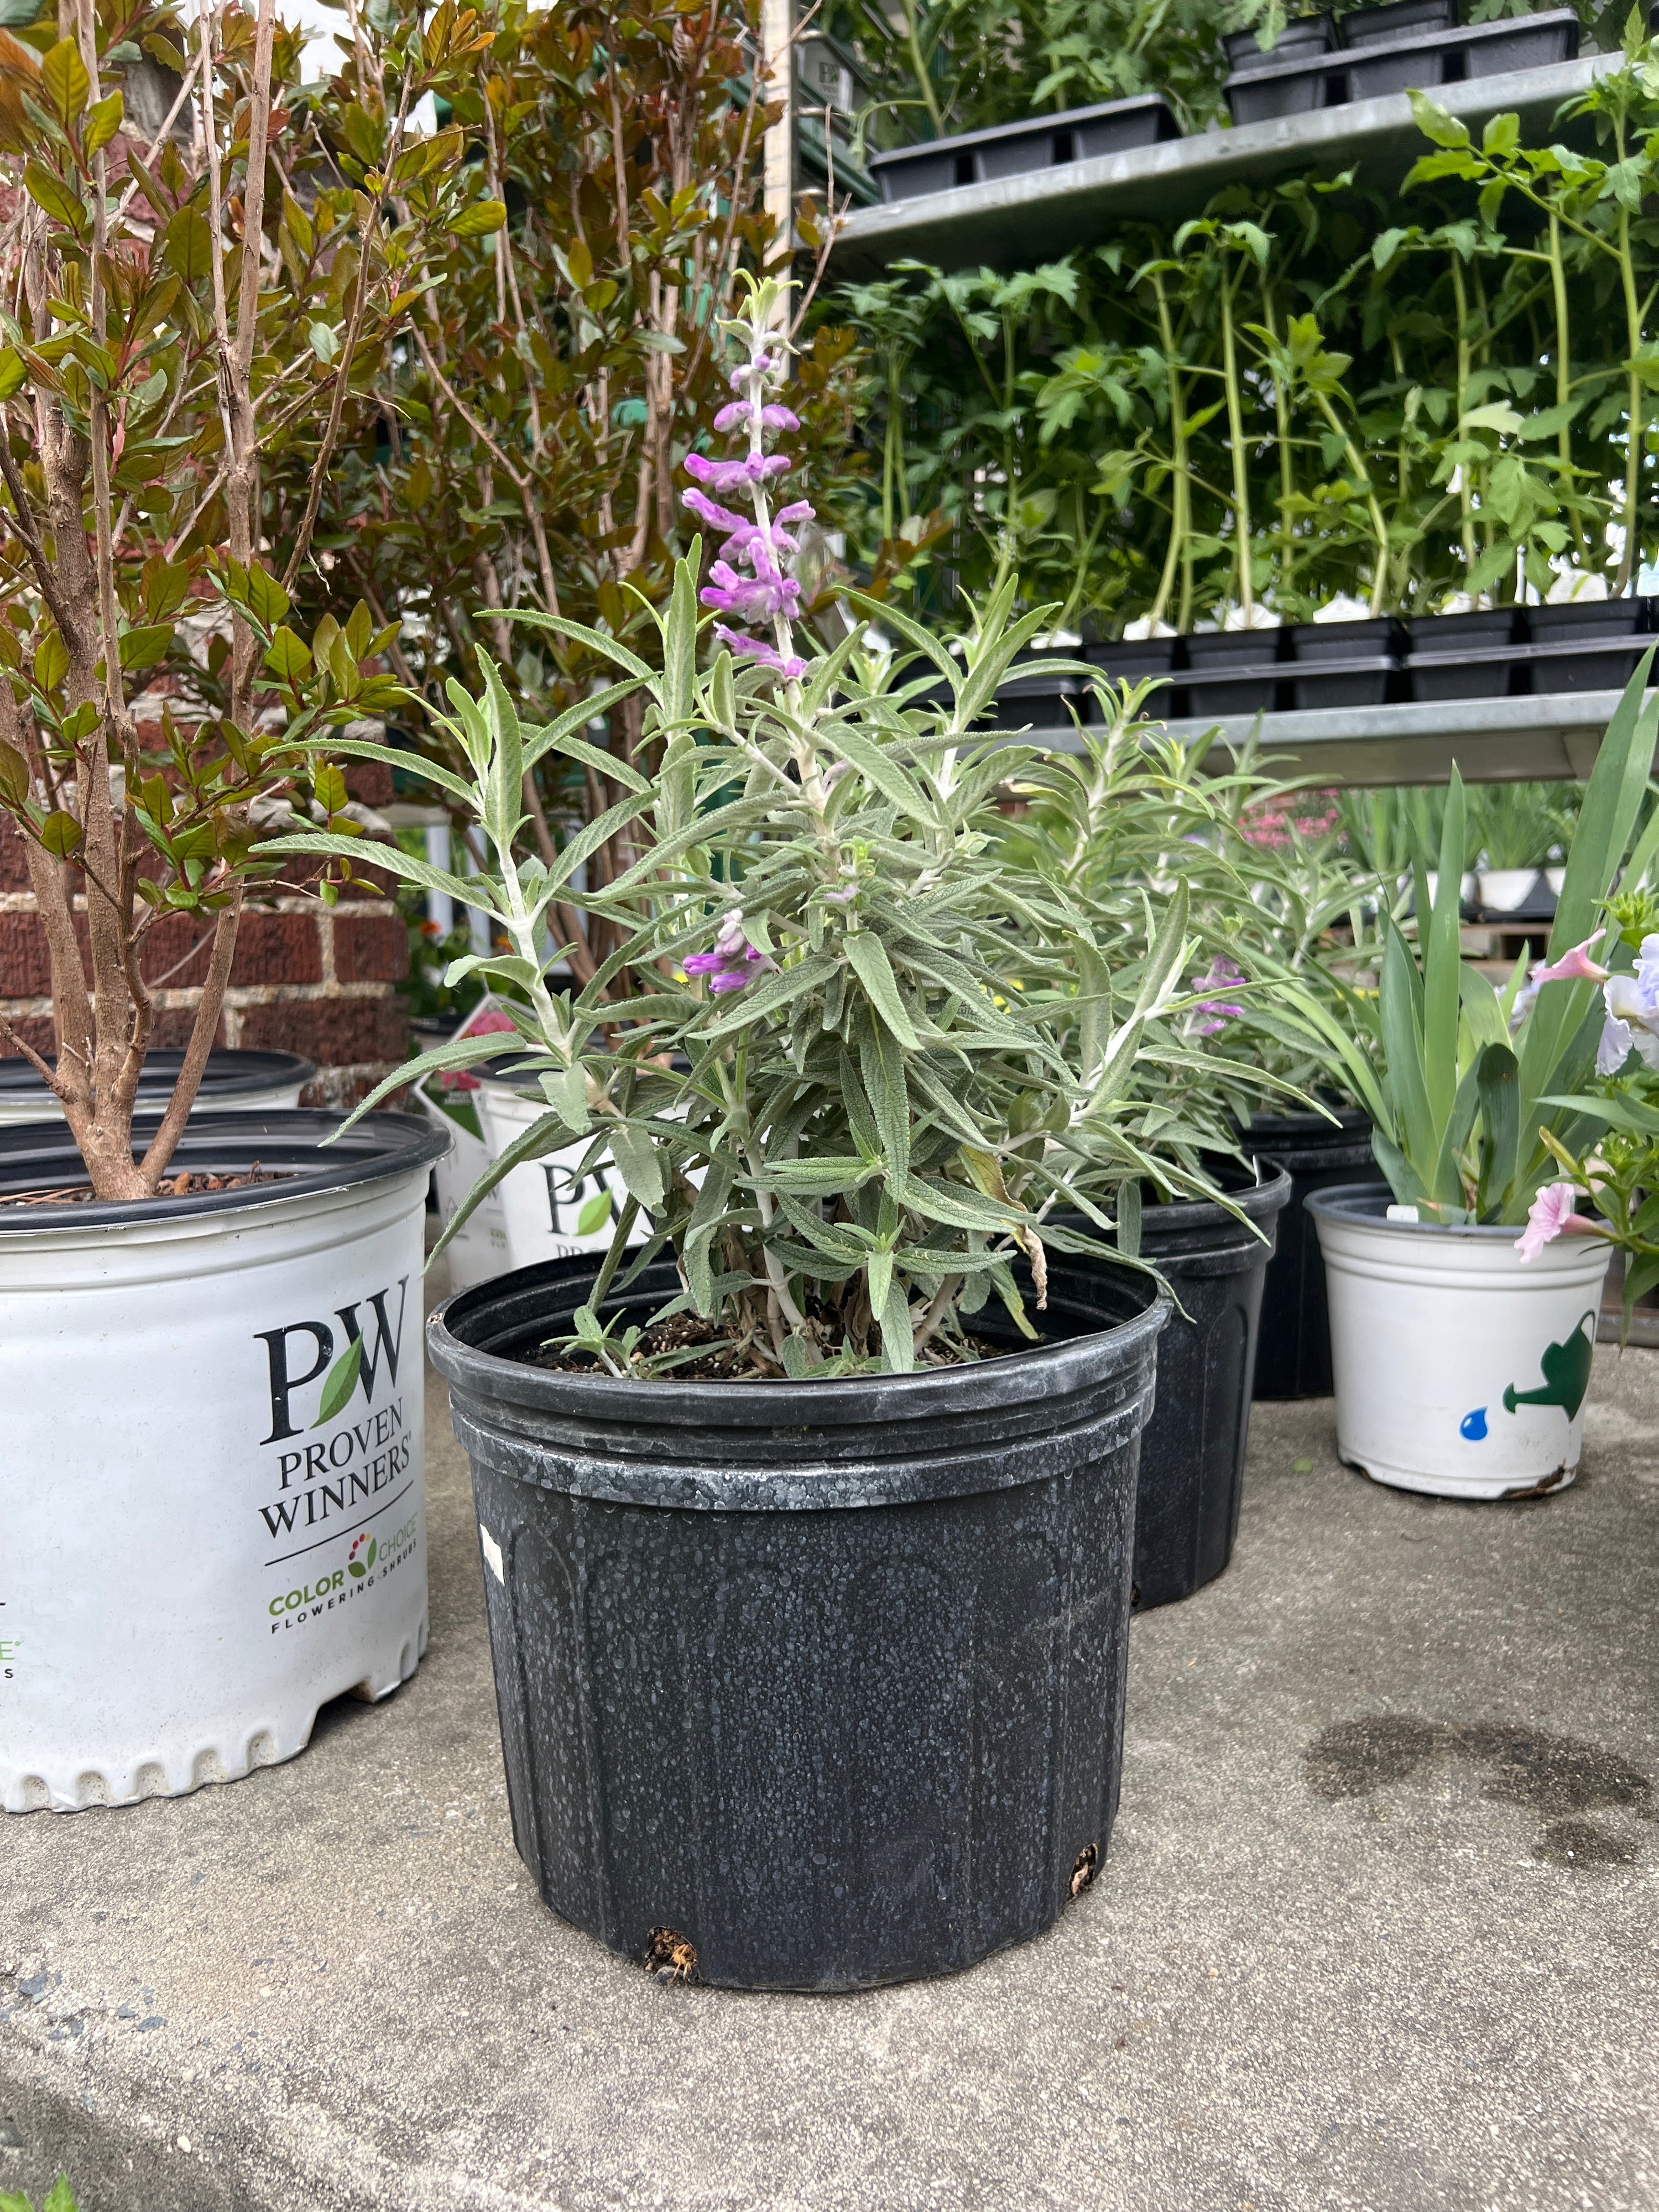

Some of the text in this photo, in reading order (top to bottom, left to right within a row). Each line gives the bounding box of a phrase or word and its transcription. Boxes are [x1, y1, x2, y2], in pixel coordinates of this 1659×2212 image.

[252, 1274, 409, 1446] PW
[277, 1396, 403, 1490] PROVEN
[269, 1511, 418, 1616] COLOR CHOICE
[272, 1576, 374, 1634] FLOWERING
